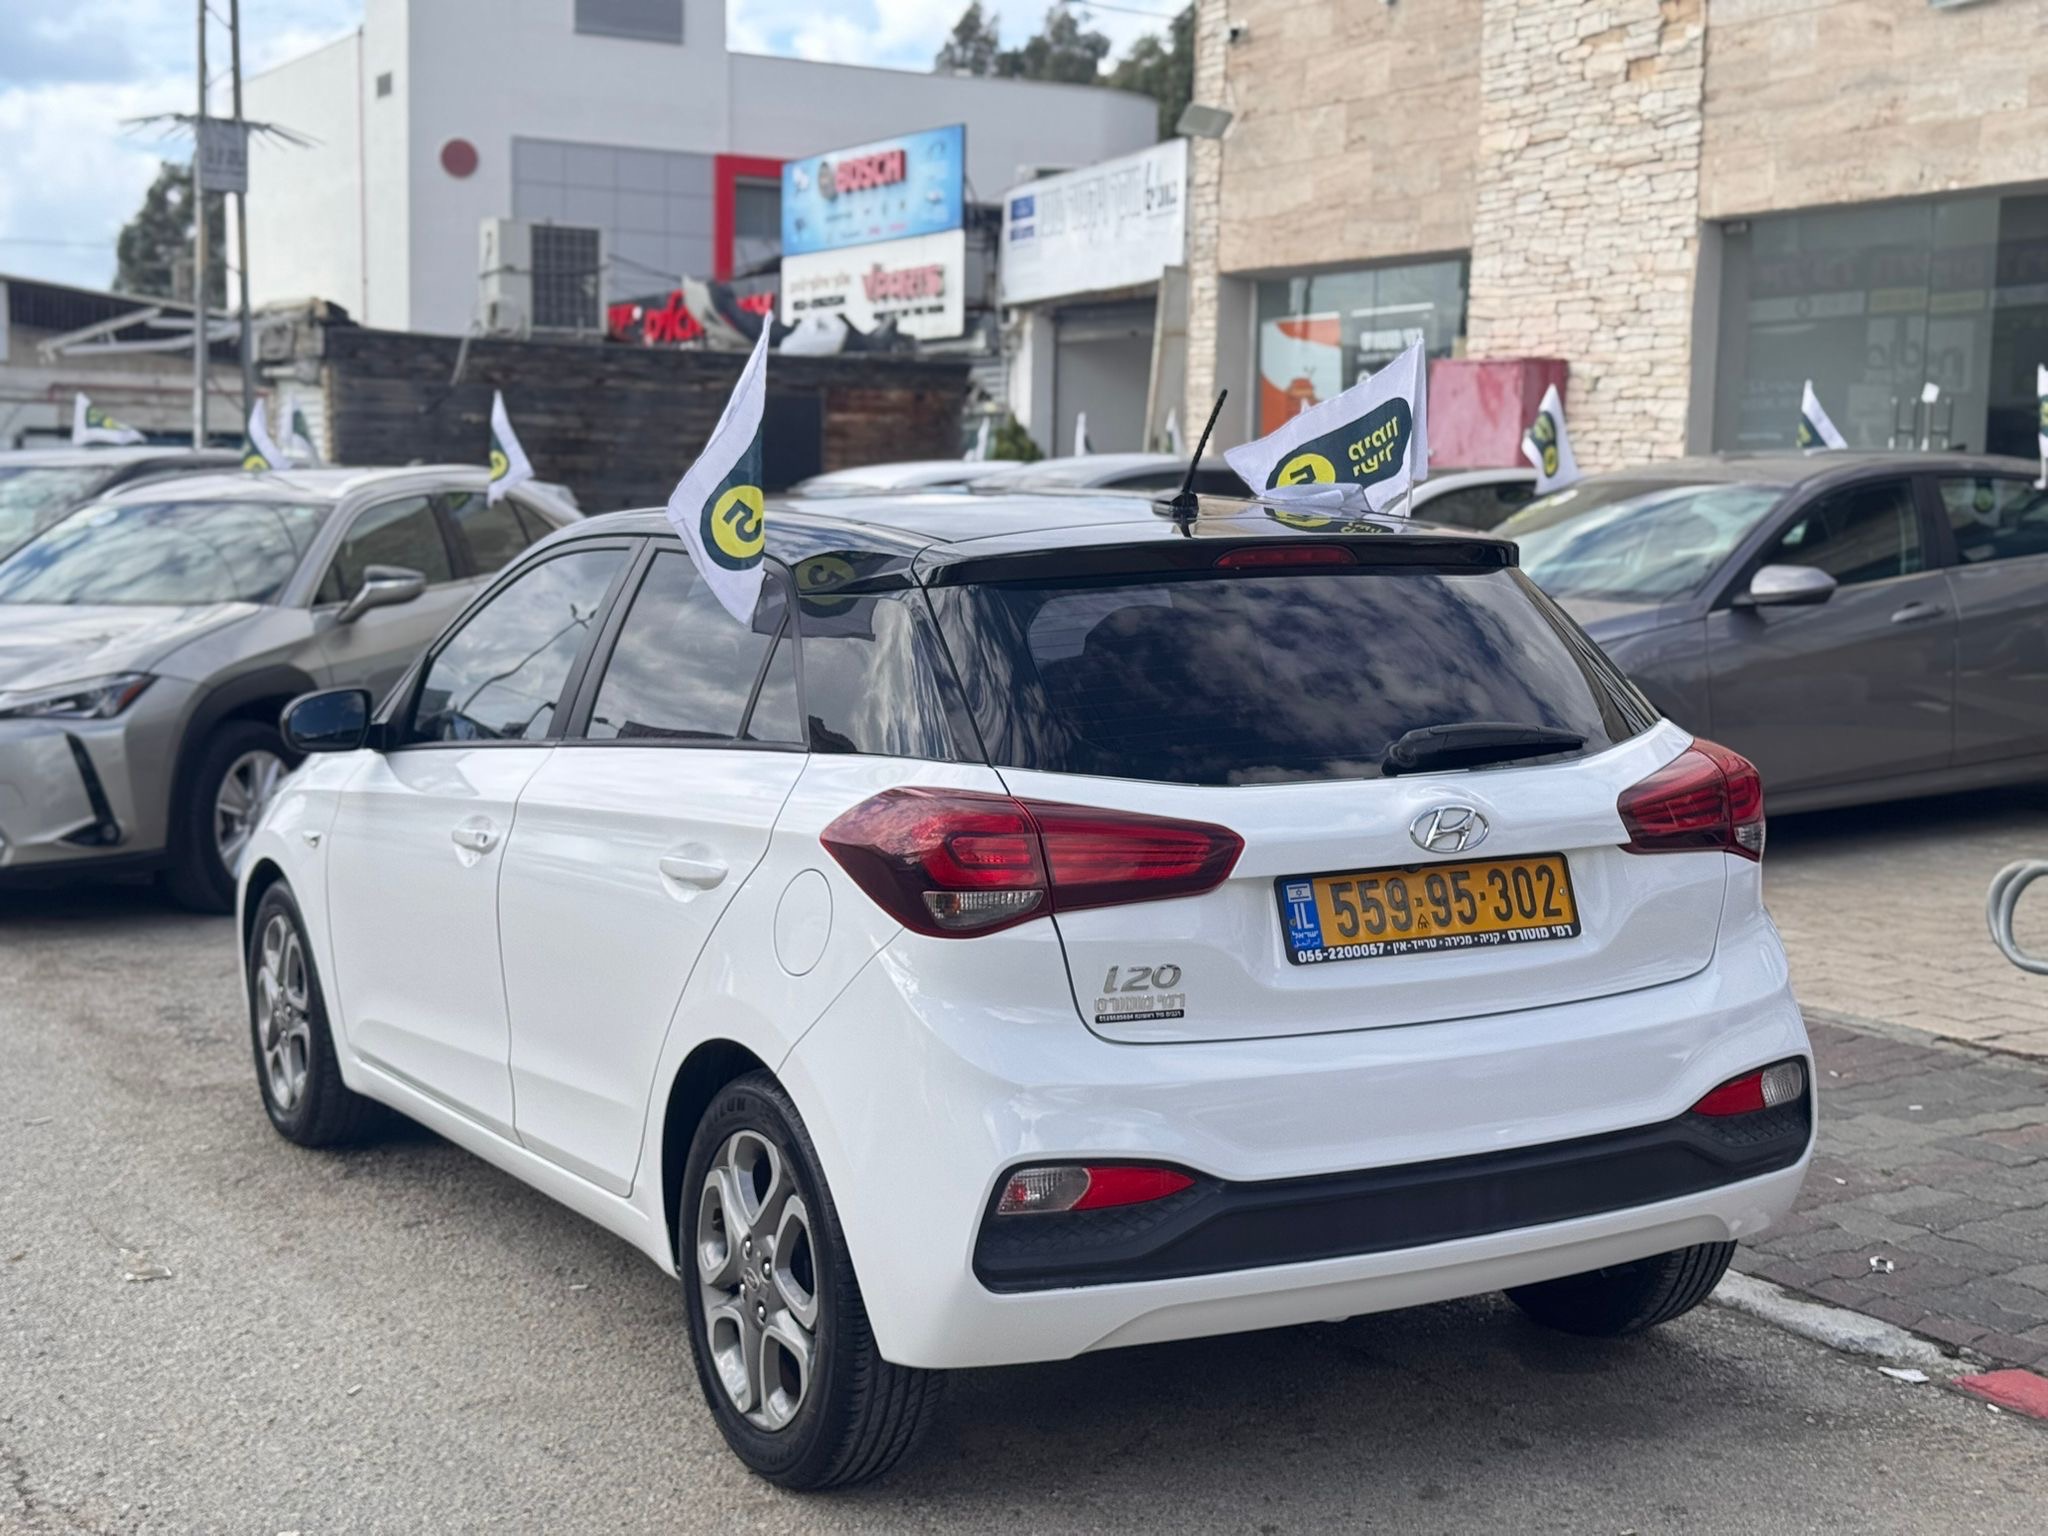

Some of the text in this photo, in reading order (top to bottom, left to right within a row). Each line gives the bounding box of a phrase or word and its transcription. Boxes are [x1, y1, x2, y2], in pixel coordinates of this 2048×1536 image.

[836, 149, 905, 193] BOSCH
[1294, 903, 1314, 929] IL
[1480, 932, 1500, 945] קניה
[1507, 926, 1549, 942] מוטורס
[1552, 924, 1573, 937] רמי
[1444, 935, 1473, 948] מכירה
[1297, 943, 1385, 963] 055-2200057
